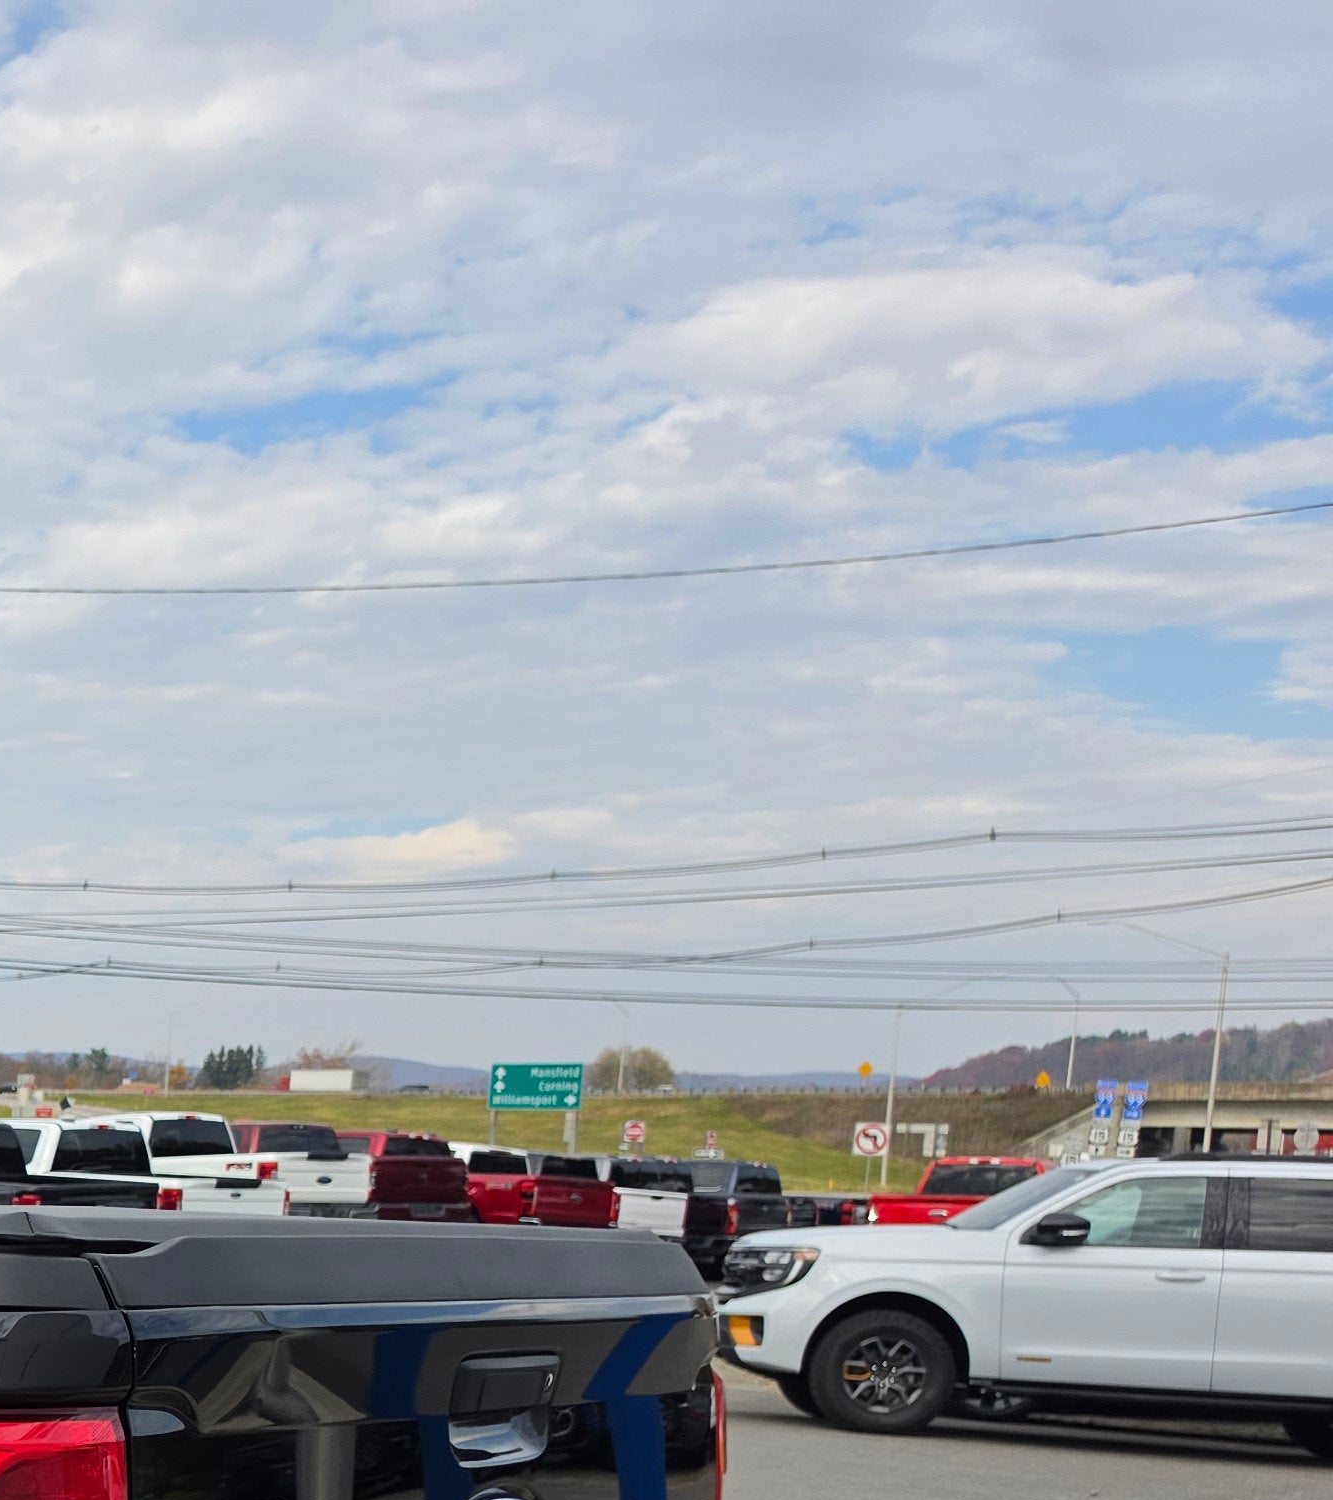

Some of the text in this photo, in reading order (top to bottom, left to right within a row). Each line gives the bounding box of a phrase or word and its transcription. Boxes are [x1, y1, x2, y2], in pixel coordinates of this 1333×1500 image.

[530, 1067, 580, 1078] Mansfield
[538, 1080, 579, 1094] Corning
[492, 1094, 557, 1108] Williamsport
